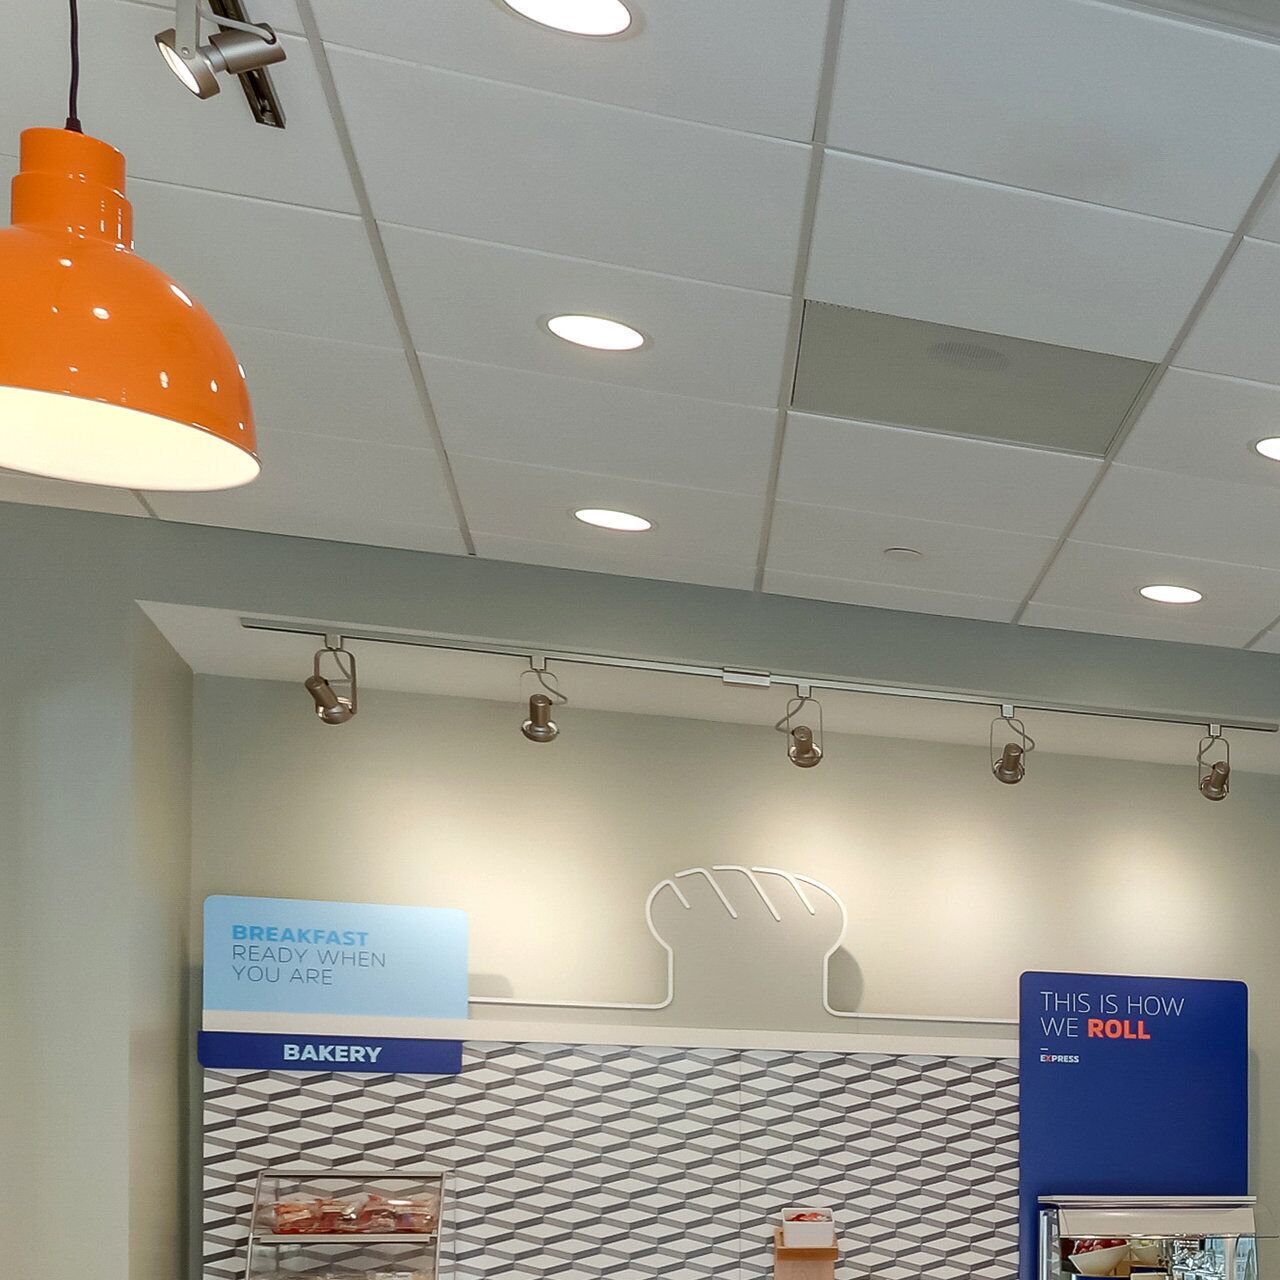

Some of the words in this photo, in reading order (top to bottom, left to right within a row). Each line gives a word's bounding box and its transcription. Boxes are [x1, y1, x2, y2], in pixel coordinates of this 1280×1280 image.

[232, 924, 369, 947] BREAKFAST
[232, 944, 308, 964] READY
[317, 950, 386, 968] WHEN
[232, 965, 280, 983] YOU
[289, 968, 333, 985] ARE
[1040, 991, 1091, 1013] THIS
[1100, 994, 1119, 1014] IS
[1127, 995, 1184, 1016] HOW
[1040, 1017, 1078, 1037] WE
[1087, 1018, 1151, 1040] ROLL
[283, 1044, 383, 1063] BAKERY
[1040, 1054, 1079, 1063] EXPRESS
